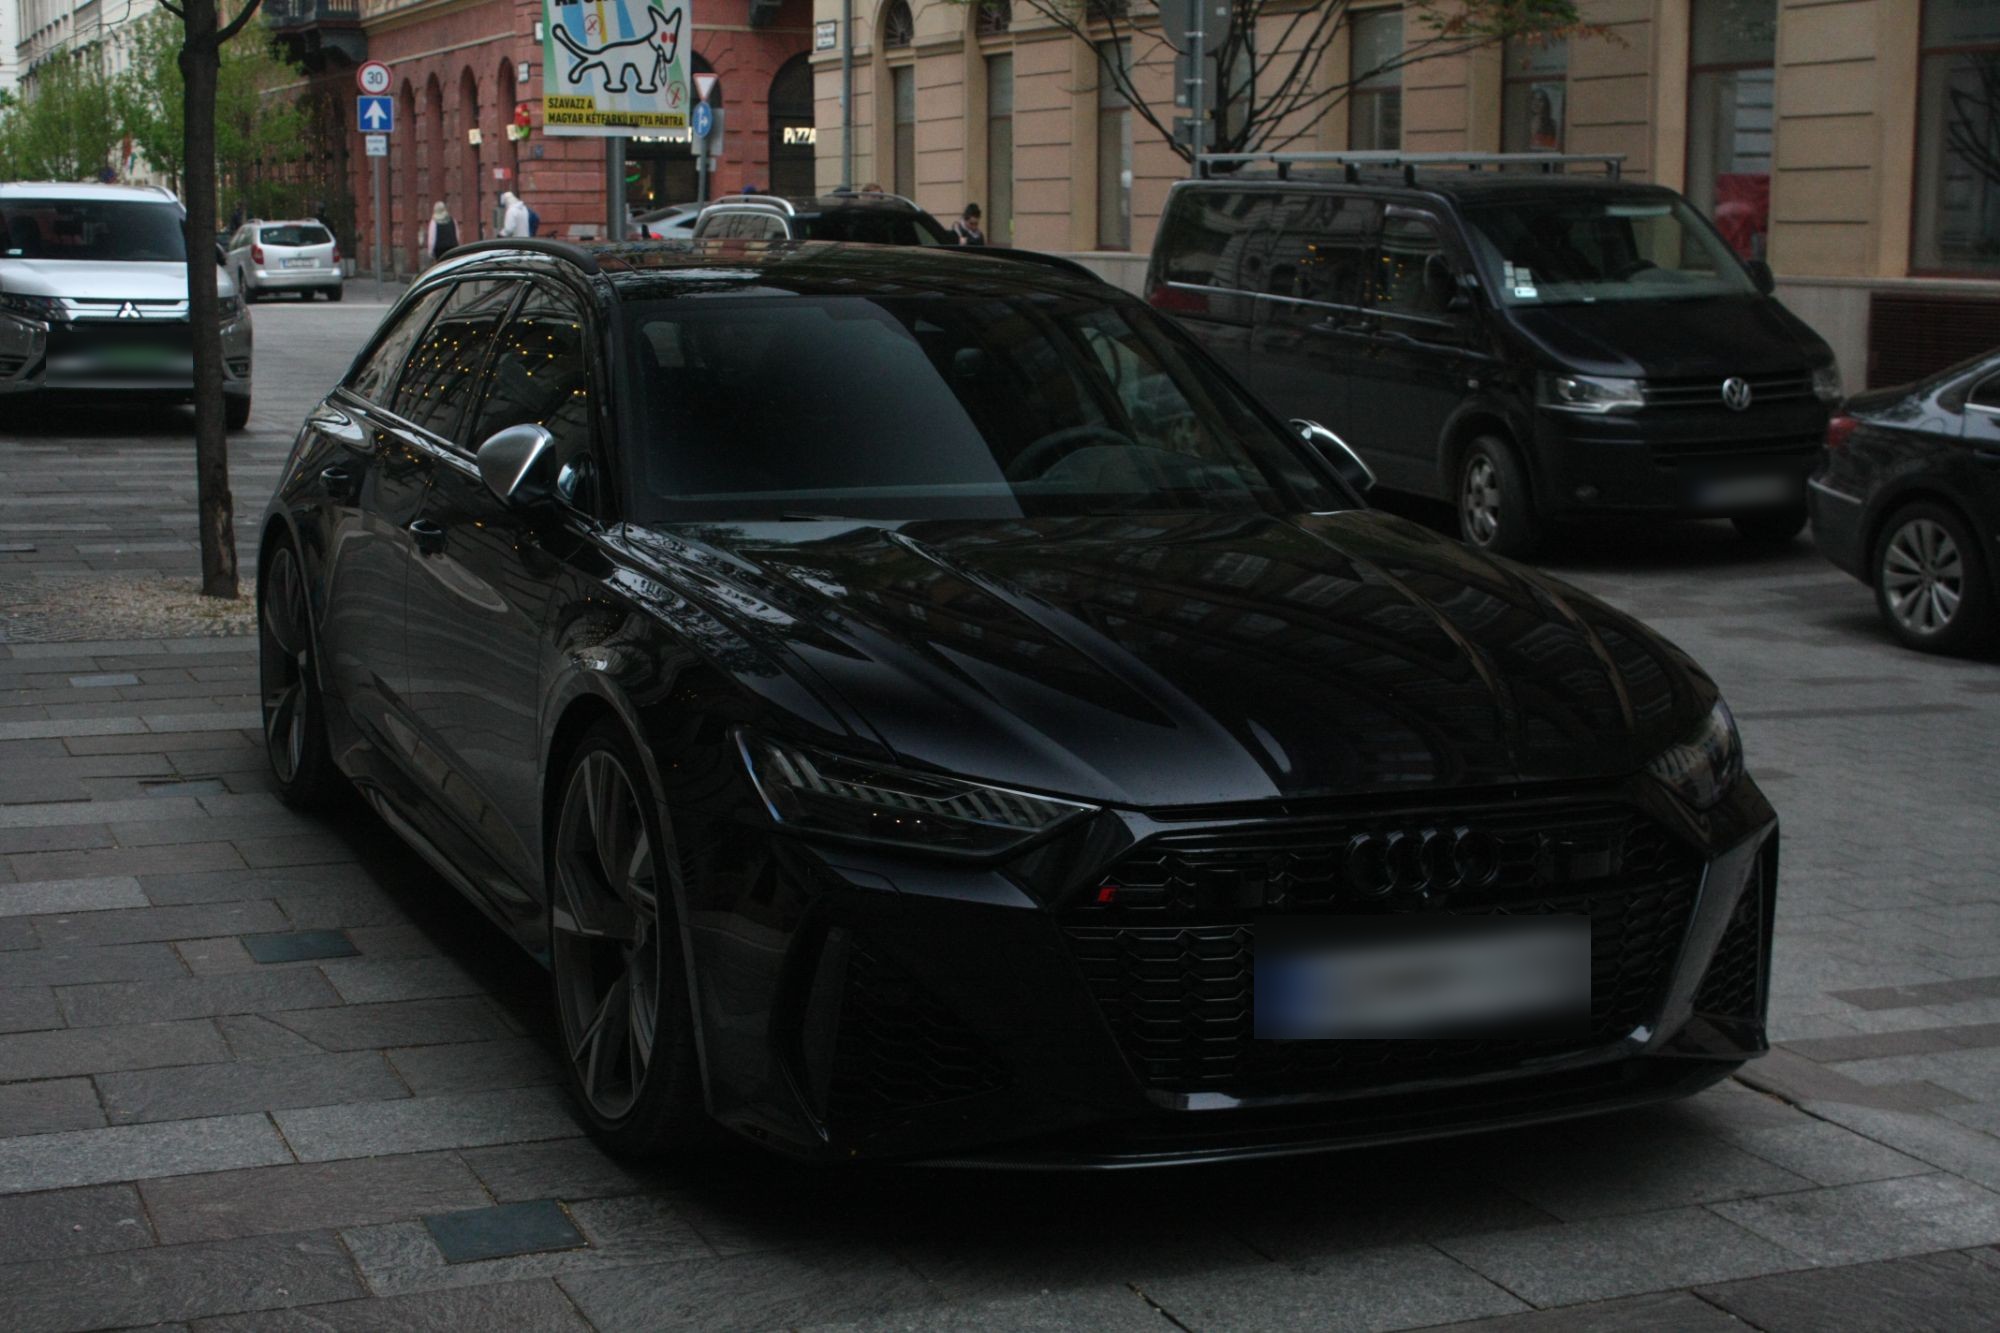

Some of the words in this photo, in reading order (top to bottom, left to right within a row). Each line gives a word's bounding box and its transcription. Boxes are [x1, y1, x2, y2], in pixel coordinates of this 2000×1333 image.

[367, 71, 383, 85] 30
[548, 98, 585, 109] SZAVAZZ
[587, 99, 593, 109] A
[548, 112, 584, 124] MAGYAR
[629, 114, 653, 126] KUTYA
[654, 113, 684, 126] PÁRTRA
